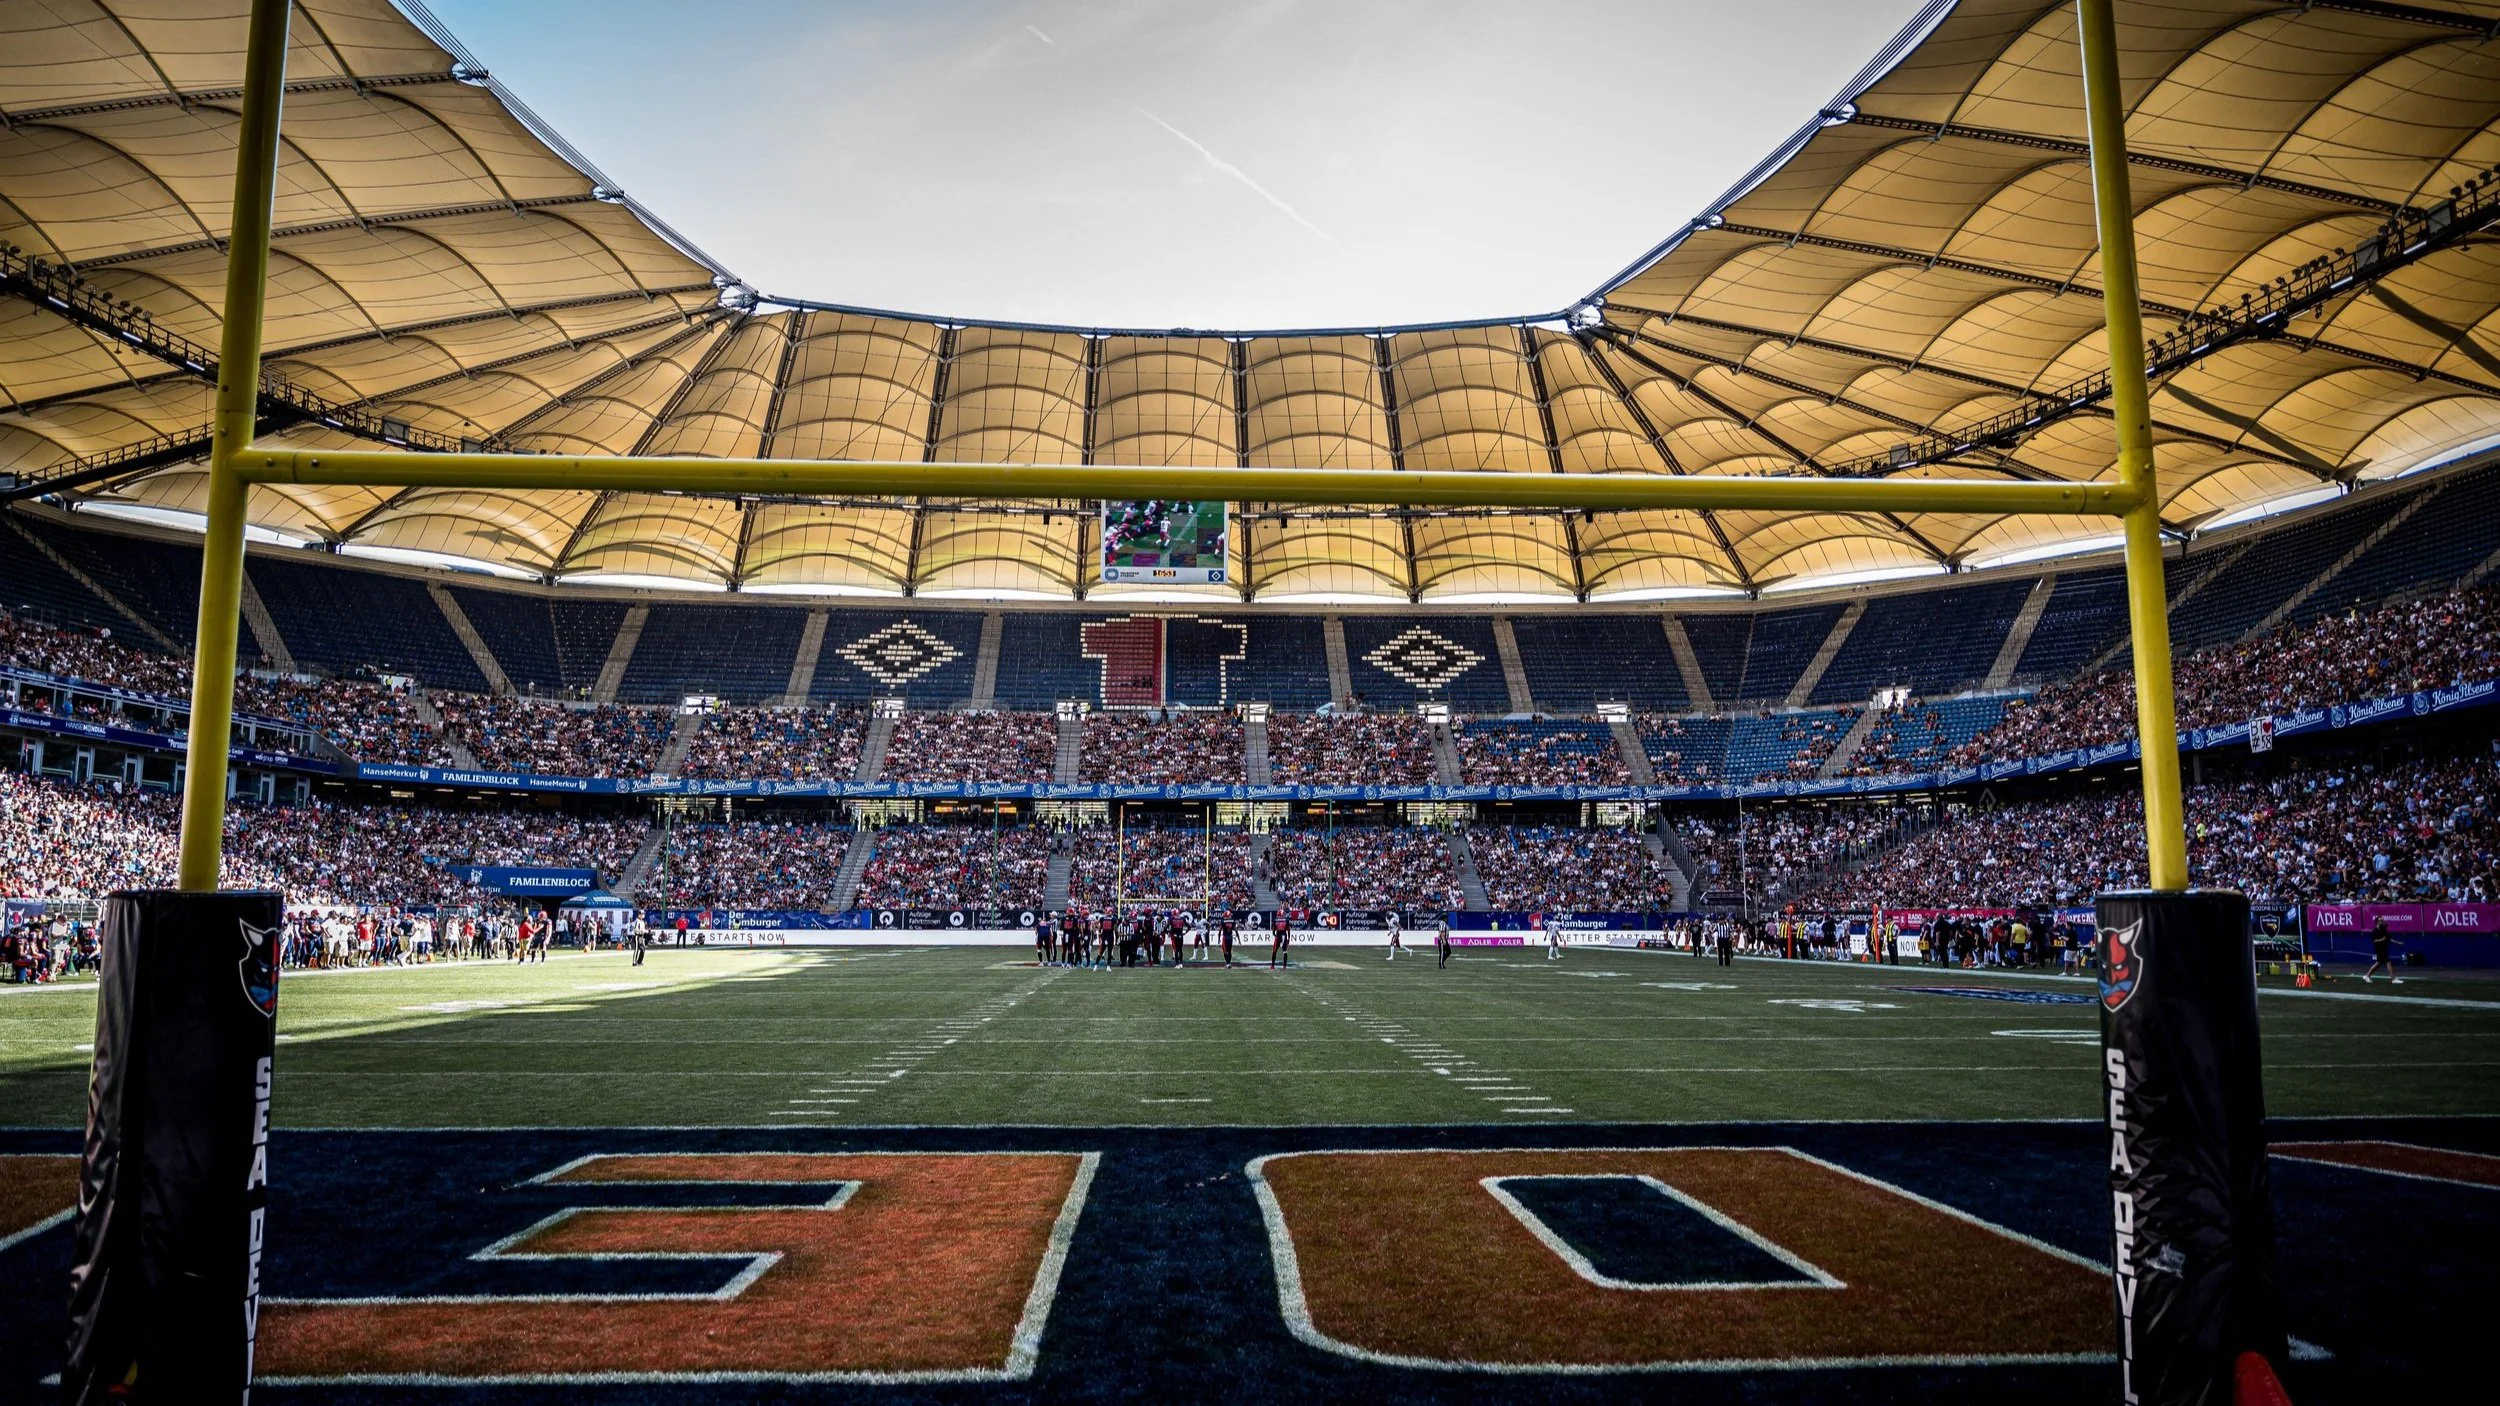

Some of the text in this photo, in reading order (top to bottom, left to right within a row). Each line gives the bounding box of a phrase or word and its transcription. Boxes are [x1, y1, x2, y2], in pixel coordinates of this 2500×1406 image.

[363, 767, 418, 778] HanseMerkur
[442, 772, 519, 785] FAMILIENBLOCK
[530, 778, 578, 788] HanseMerkur
[509, 877, 591, 887] FAMILIENBLOCK
[729, 918, 782, 928] Hmburger
[1326, 916, 1337, 925] 40
[2316, 911, 2353, 926] ADLER
[2434, 909, 2479, 927] ADLER
[709, 933, 752, 941] STARTS
[759, 933, 785, 941] NOW
[1243, 934, 1271, 942] STAR
[1900, 941, 1917, 951] NOW
[2106, 1047, 2133, 1175] SEA
[247, 1056, 271, 1191] SEA
